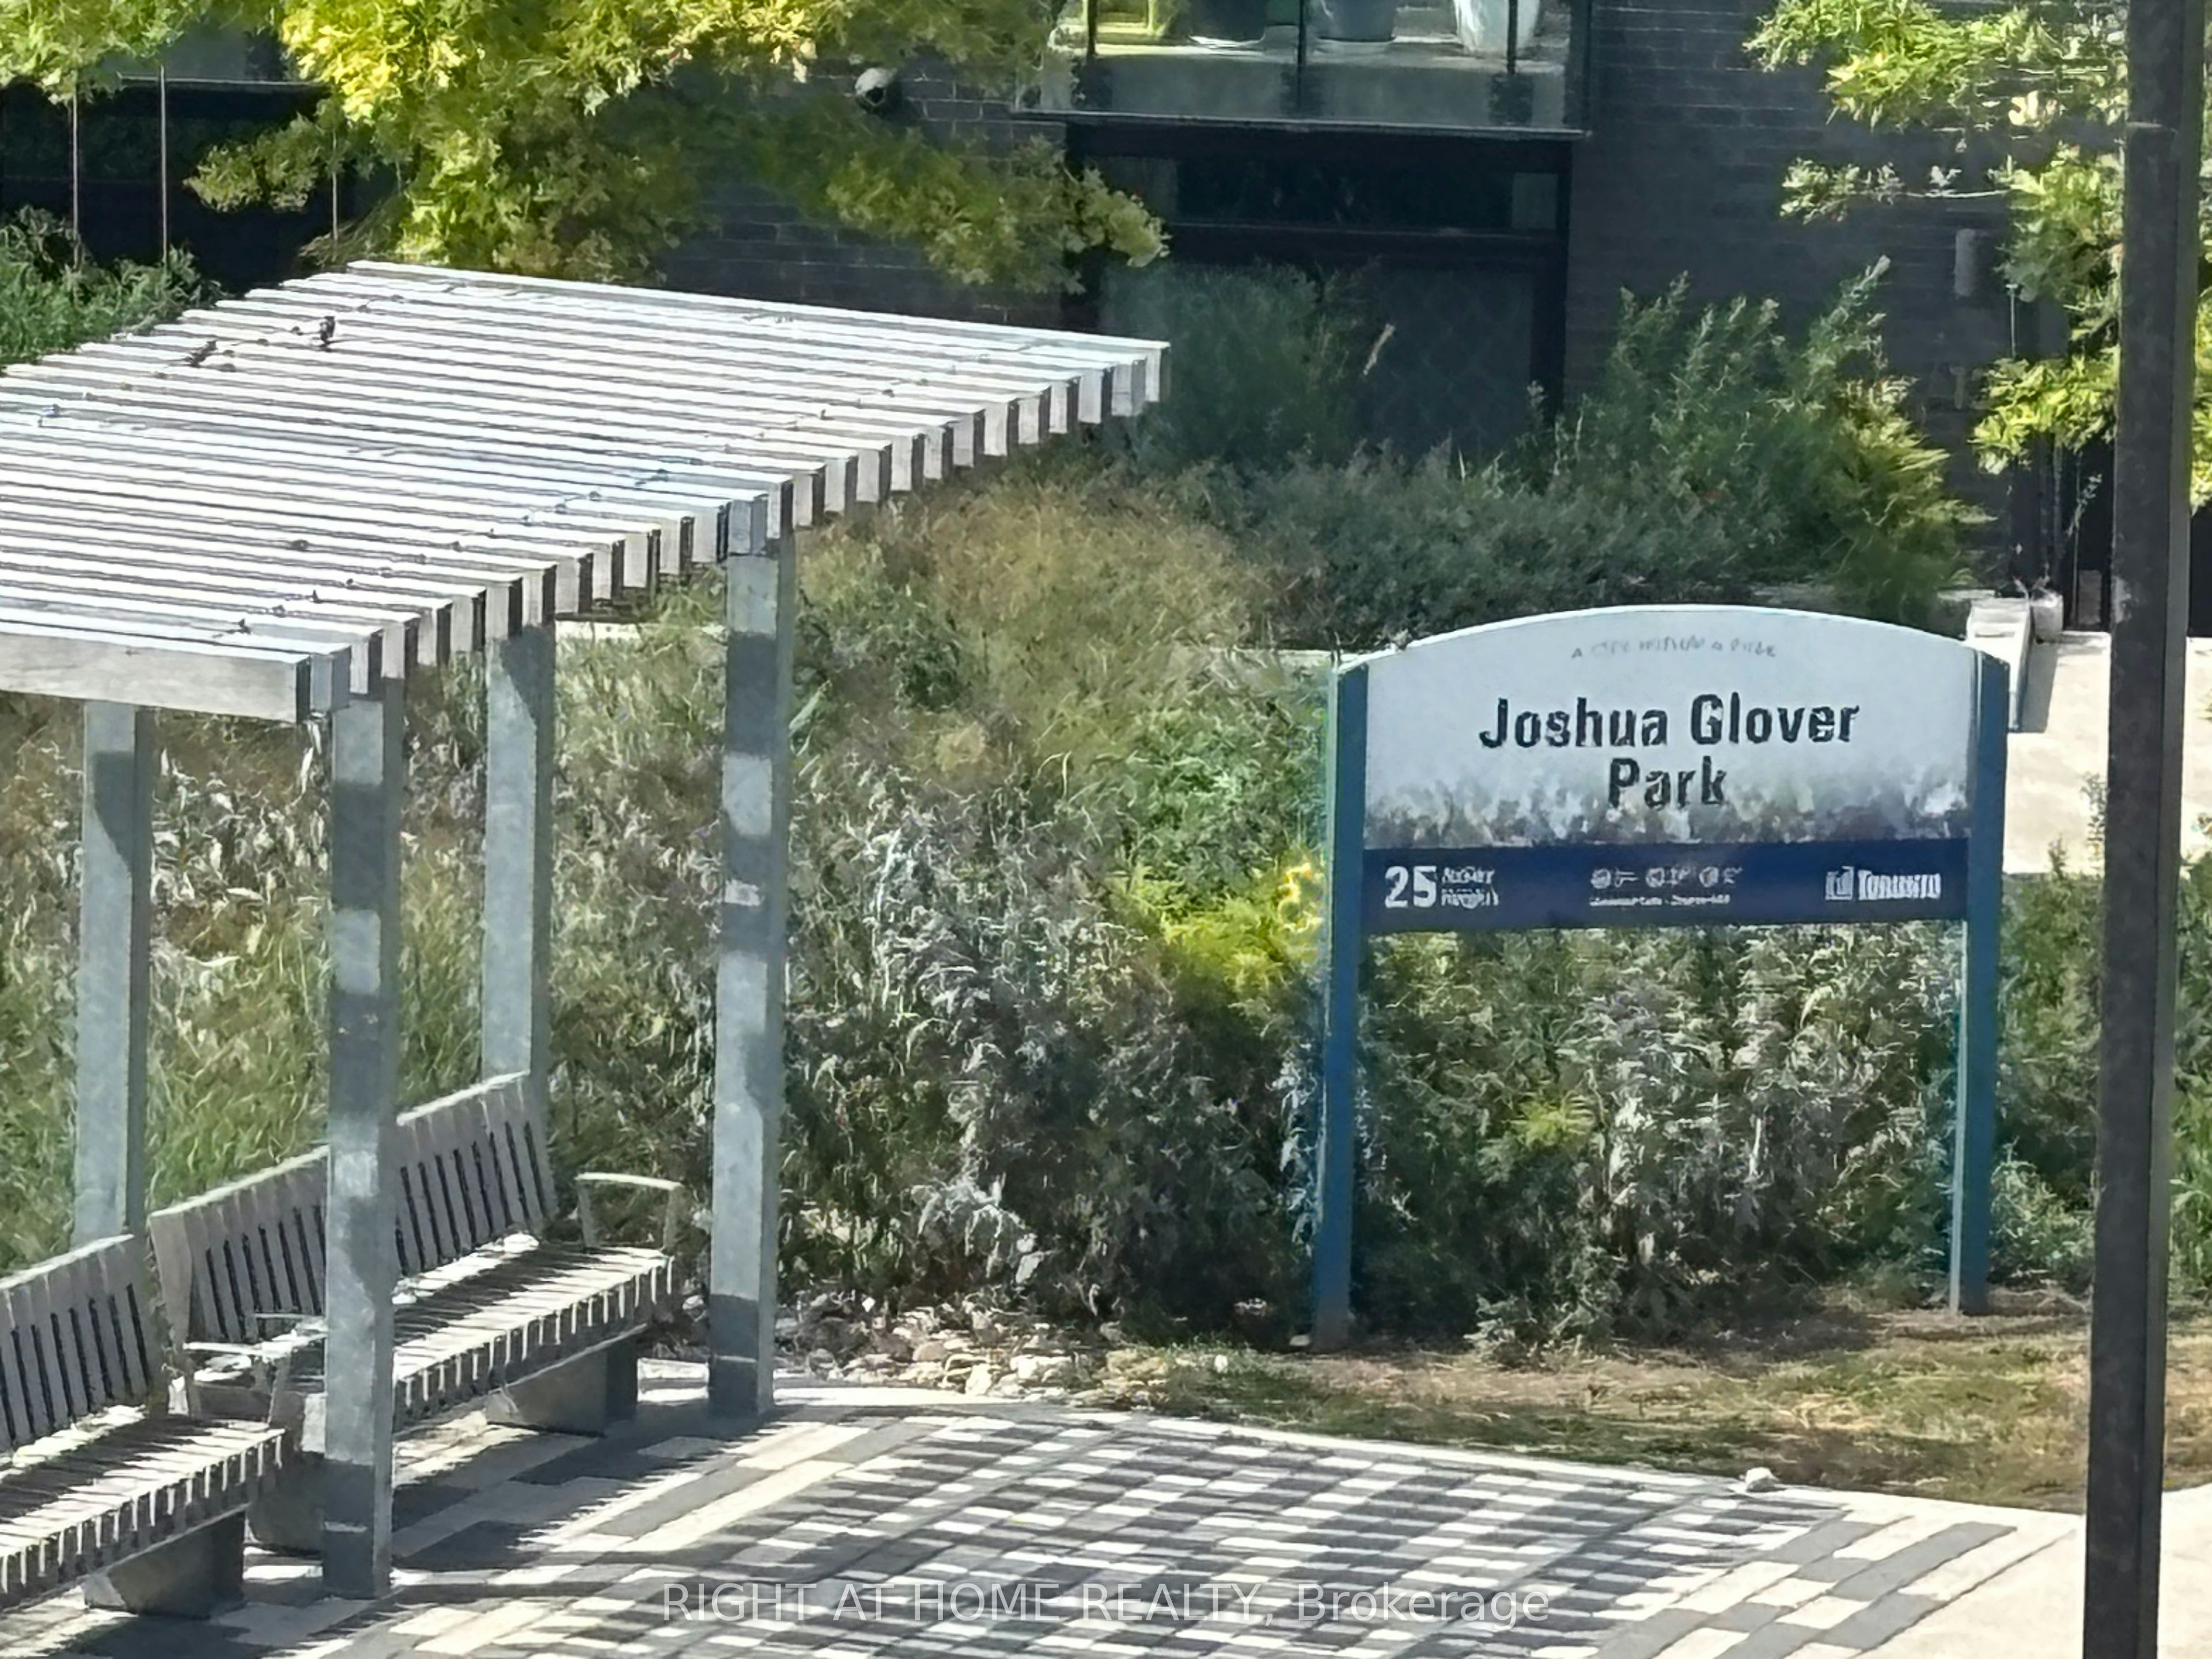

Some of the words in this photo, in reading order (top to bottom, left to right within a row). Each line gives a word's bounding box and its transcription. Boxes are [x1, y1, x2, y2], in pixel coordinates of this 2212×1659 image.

[1479, 697, 1668, 748] Joshua
[1691, 691, 1859, 745] Glover
[1608, 755, 1728, 809] Park
[1385, 865, 1437, 908] 25
